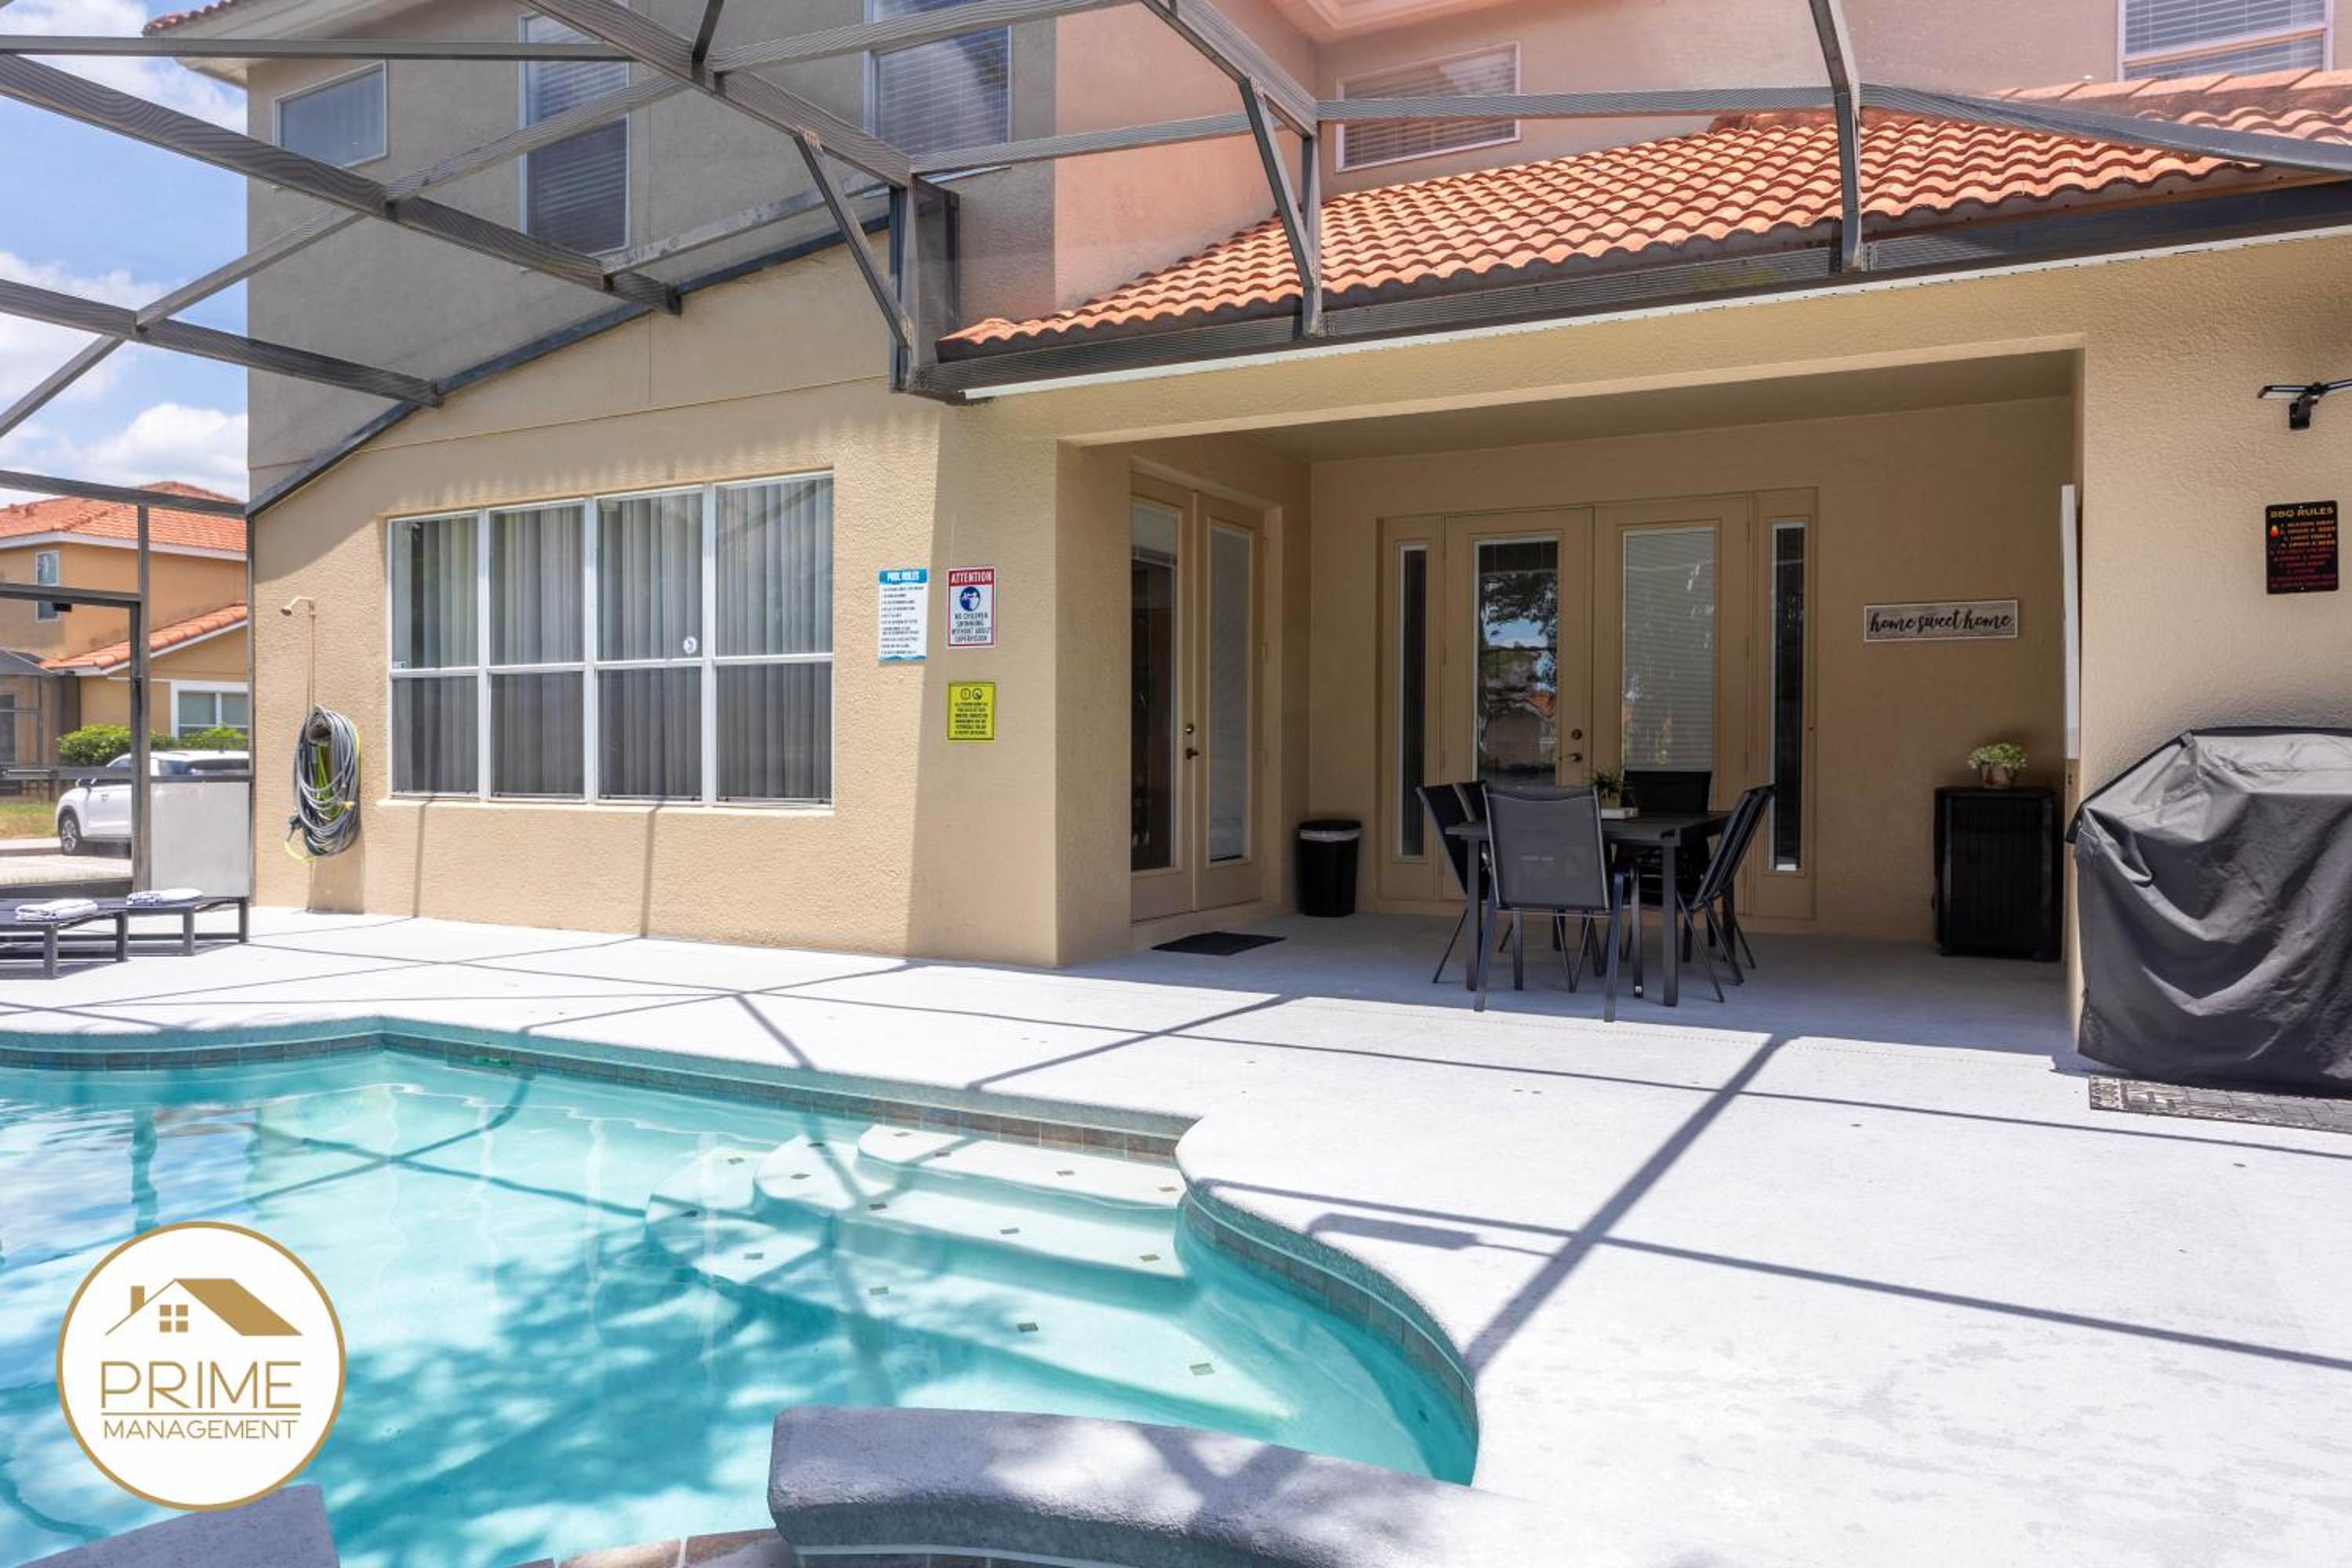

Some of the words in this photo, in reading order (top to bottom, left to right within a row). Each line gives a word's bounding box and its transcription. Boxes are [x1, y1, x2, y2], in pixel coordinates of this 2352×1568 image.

[2297, 506, 2334, 516] RULES
[951, 571, 992, 583] ATTENTION
[1870, 612, 1915, 633] home
[1916, 609, 1961, 633] sweet
[1962, 609, 2013, 630] home
